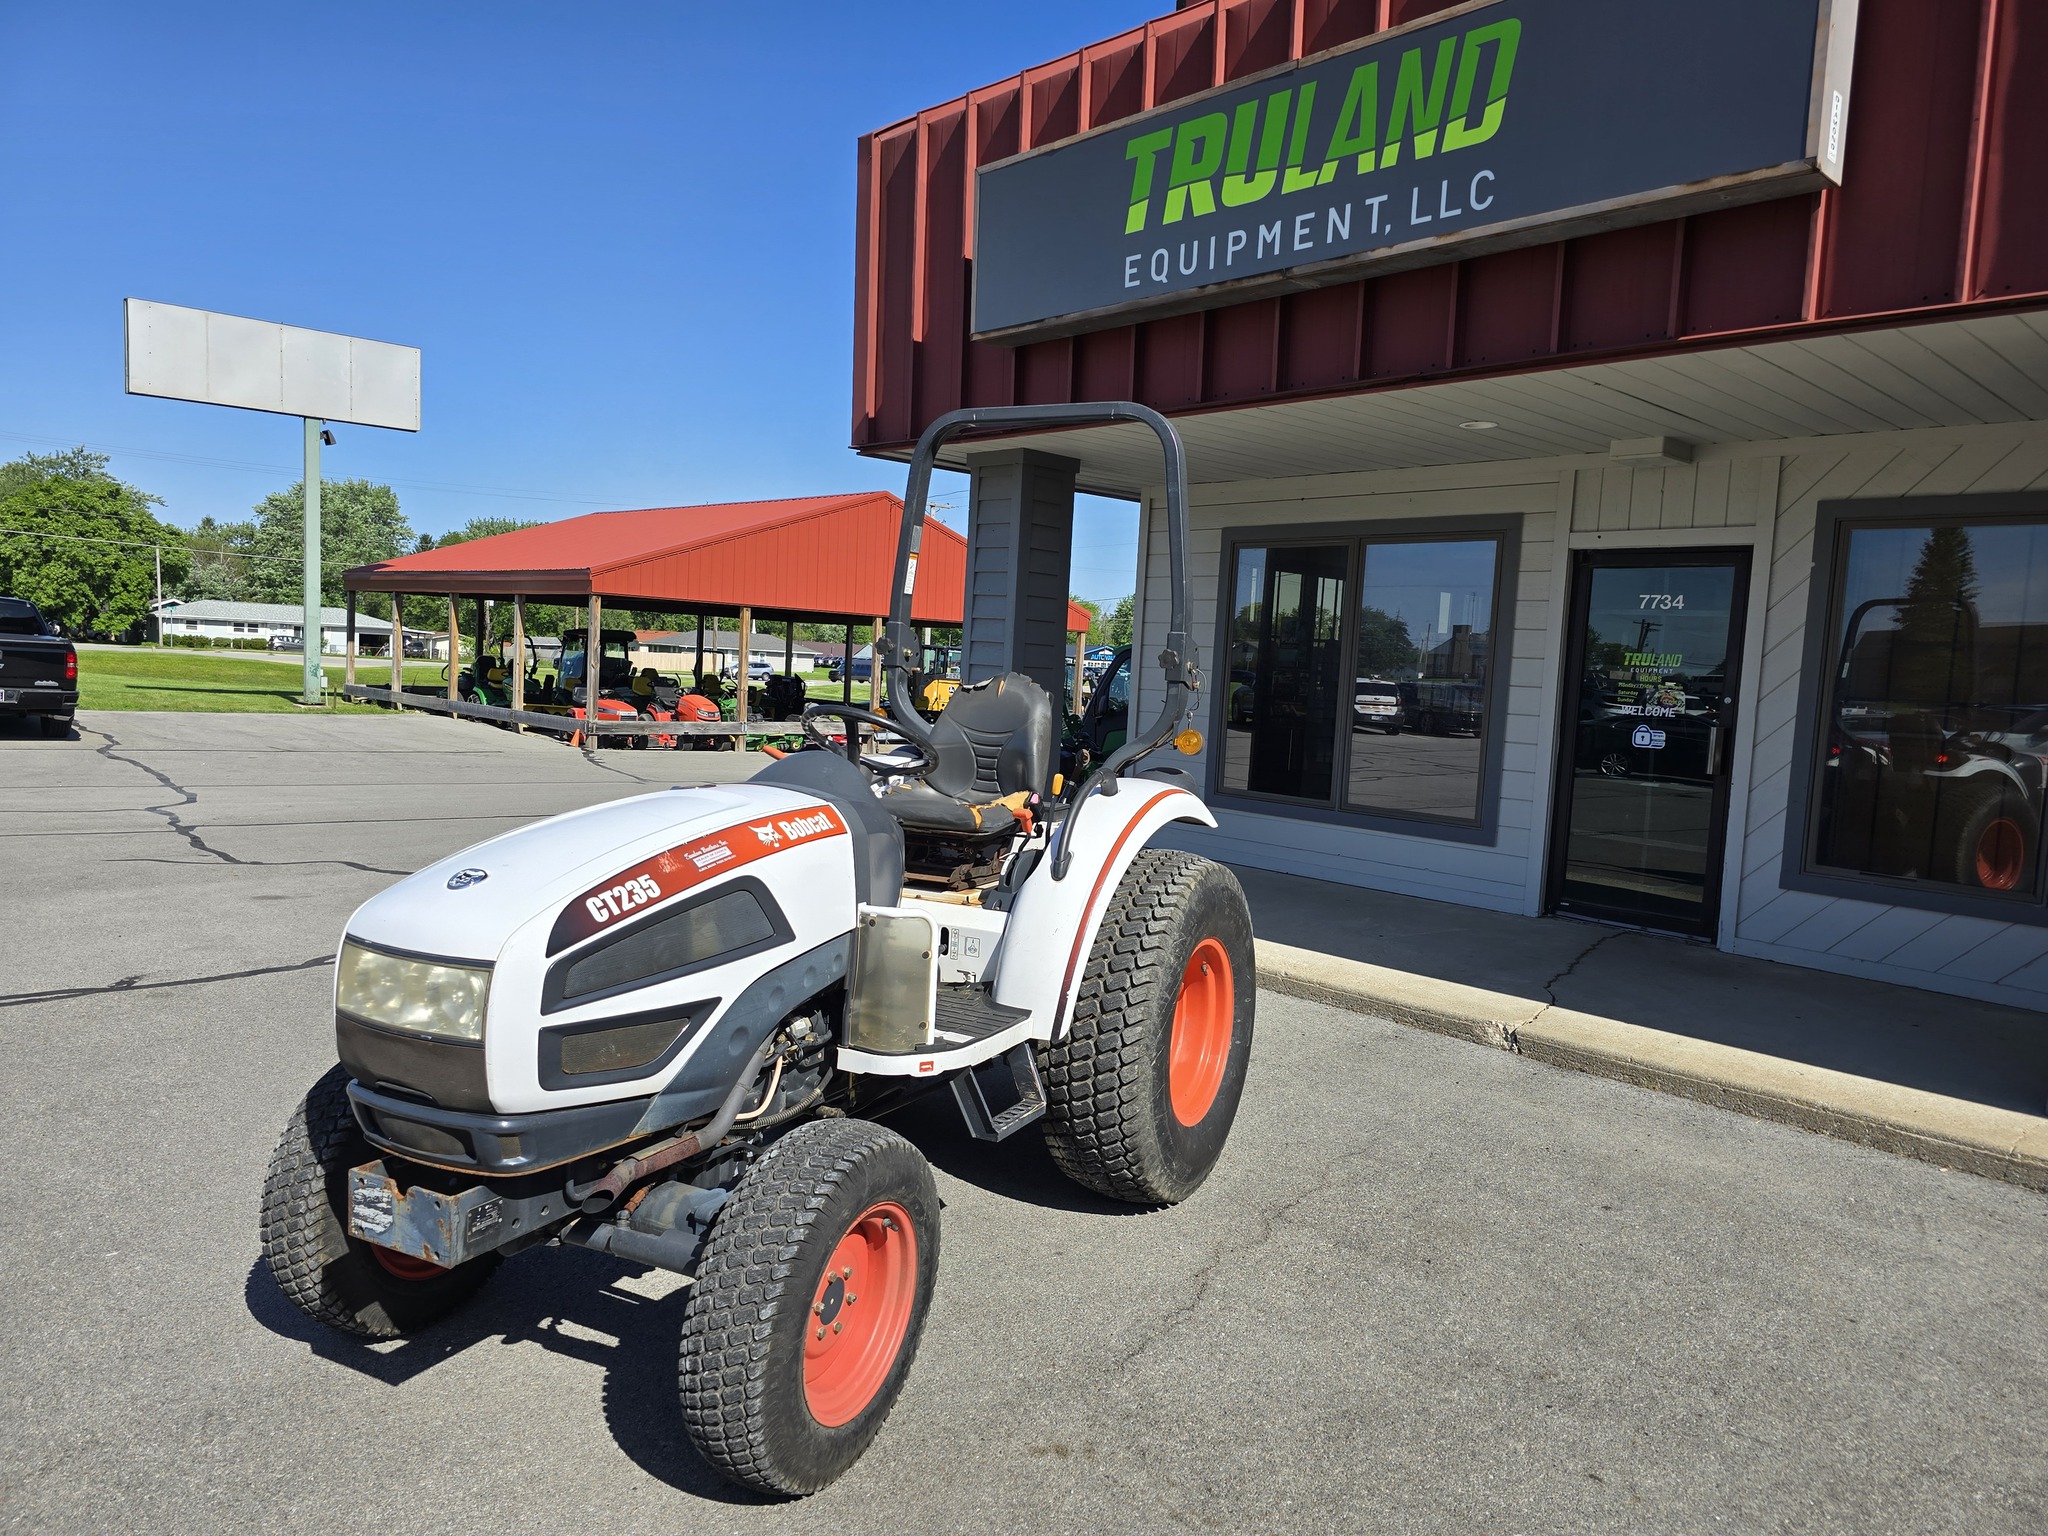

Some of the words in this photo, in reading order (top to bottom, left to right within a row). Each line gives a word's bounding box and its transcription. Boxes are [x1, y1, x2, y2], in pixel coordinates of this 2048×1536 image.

[1125, 18, 1522, 235] TRULAND
[1125, 194, 1391, 289] EQUIPMENT,
[1410, 170, 1495, 226] LLC
[1639, 594, 1685, 610] 7734
[1624, 652, 1683, 667] TRULAND
[1620, 705, 1676, 718] WELCOME
[777, 811, 835, 841] Bobcat
[585, 873, 661, 923] CT235
